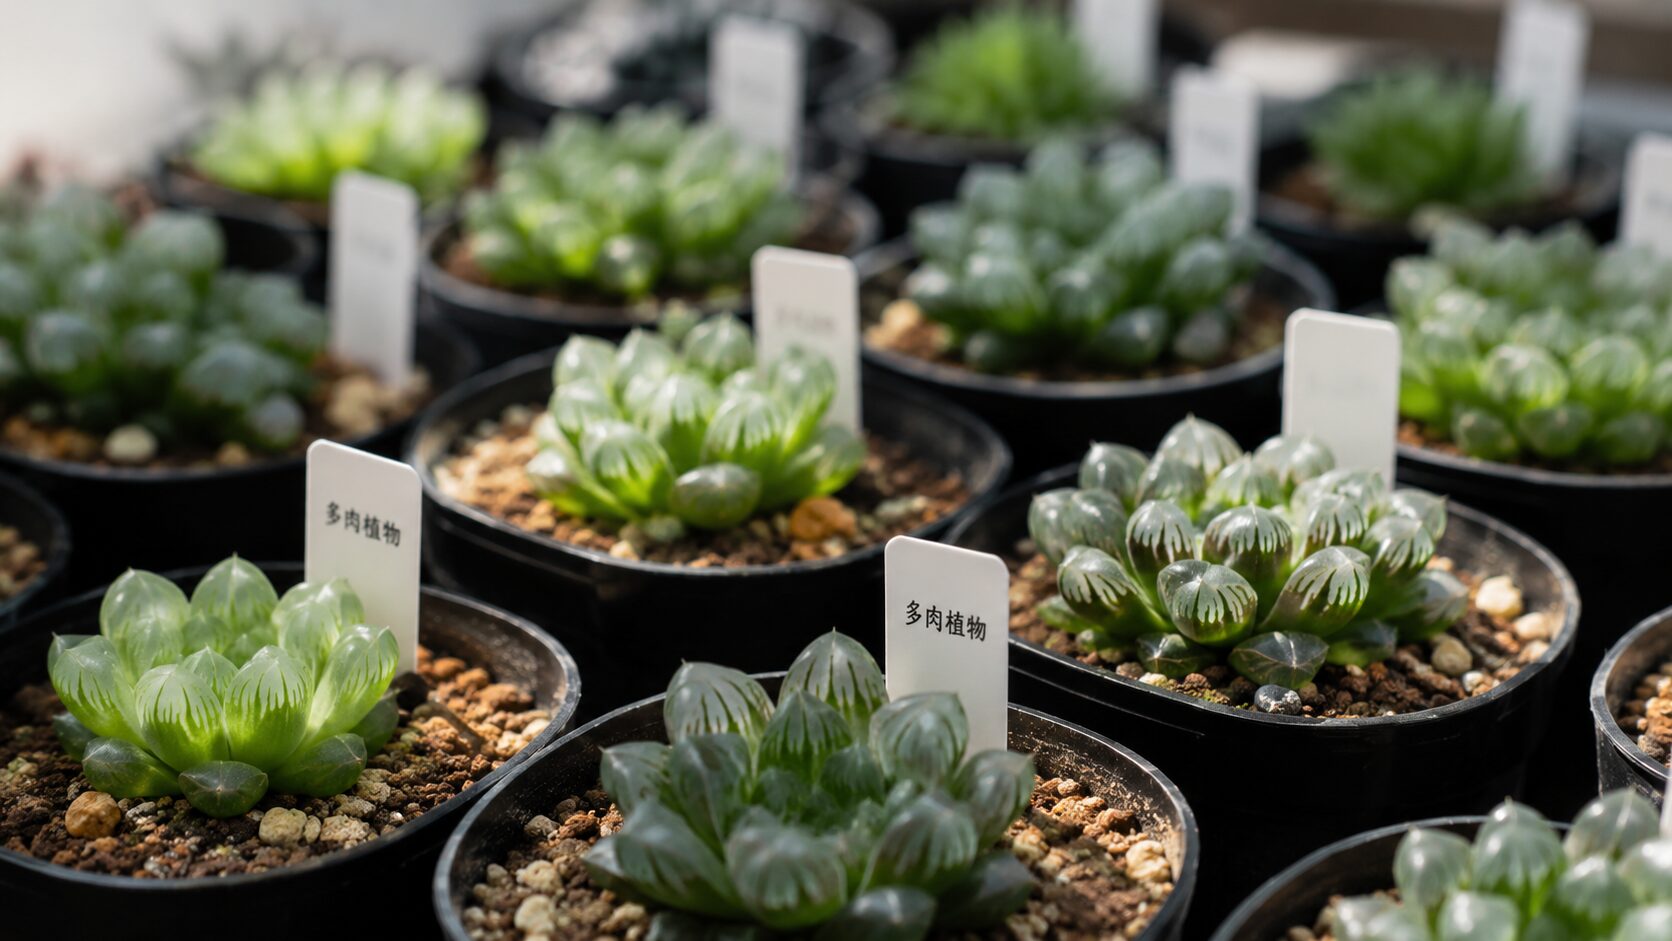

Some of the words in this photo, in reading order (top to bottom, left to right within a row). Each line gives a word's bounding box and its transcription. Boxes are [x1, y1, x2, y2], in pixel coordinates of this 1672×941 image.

[325, 501, 401, 548] 多肉植物
[905, 600, 987, 642] 多肉植物
